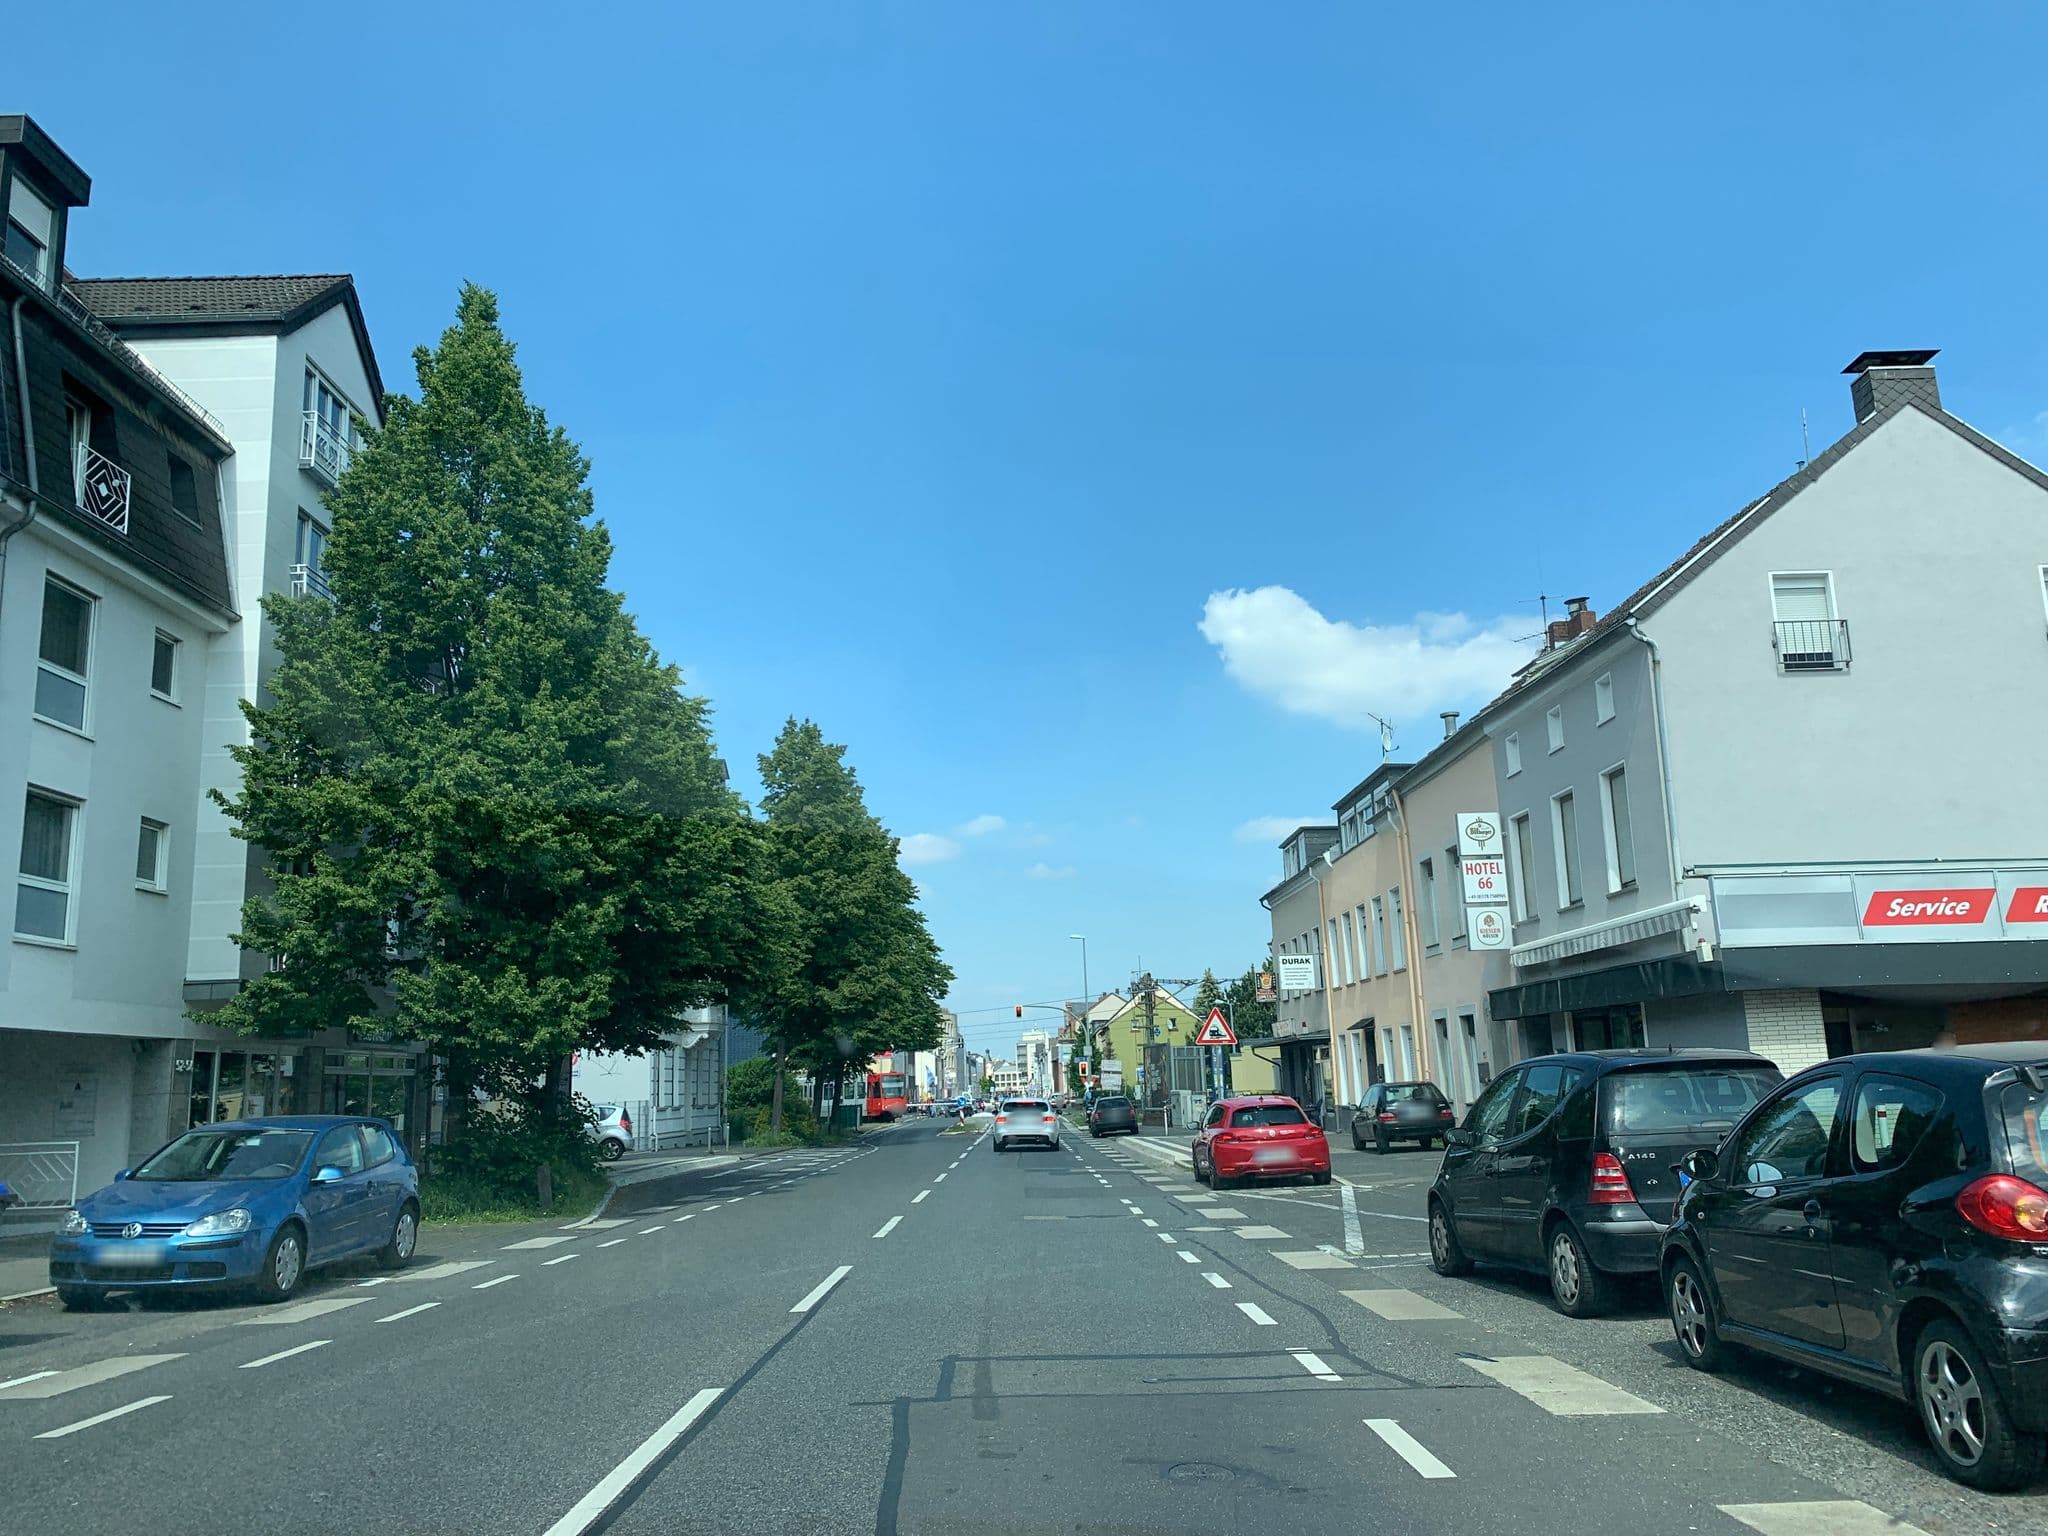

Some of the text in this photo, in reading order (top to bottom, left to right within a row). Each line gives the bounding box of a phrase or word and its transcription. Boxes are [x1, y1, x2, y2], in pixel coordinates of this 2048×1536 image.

[1465, 862, 1503, 875] HOTEL
[1478, 877, 1493, 889] 66
[1886, 897, 1971, 917] Service
